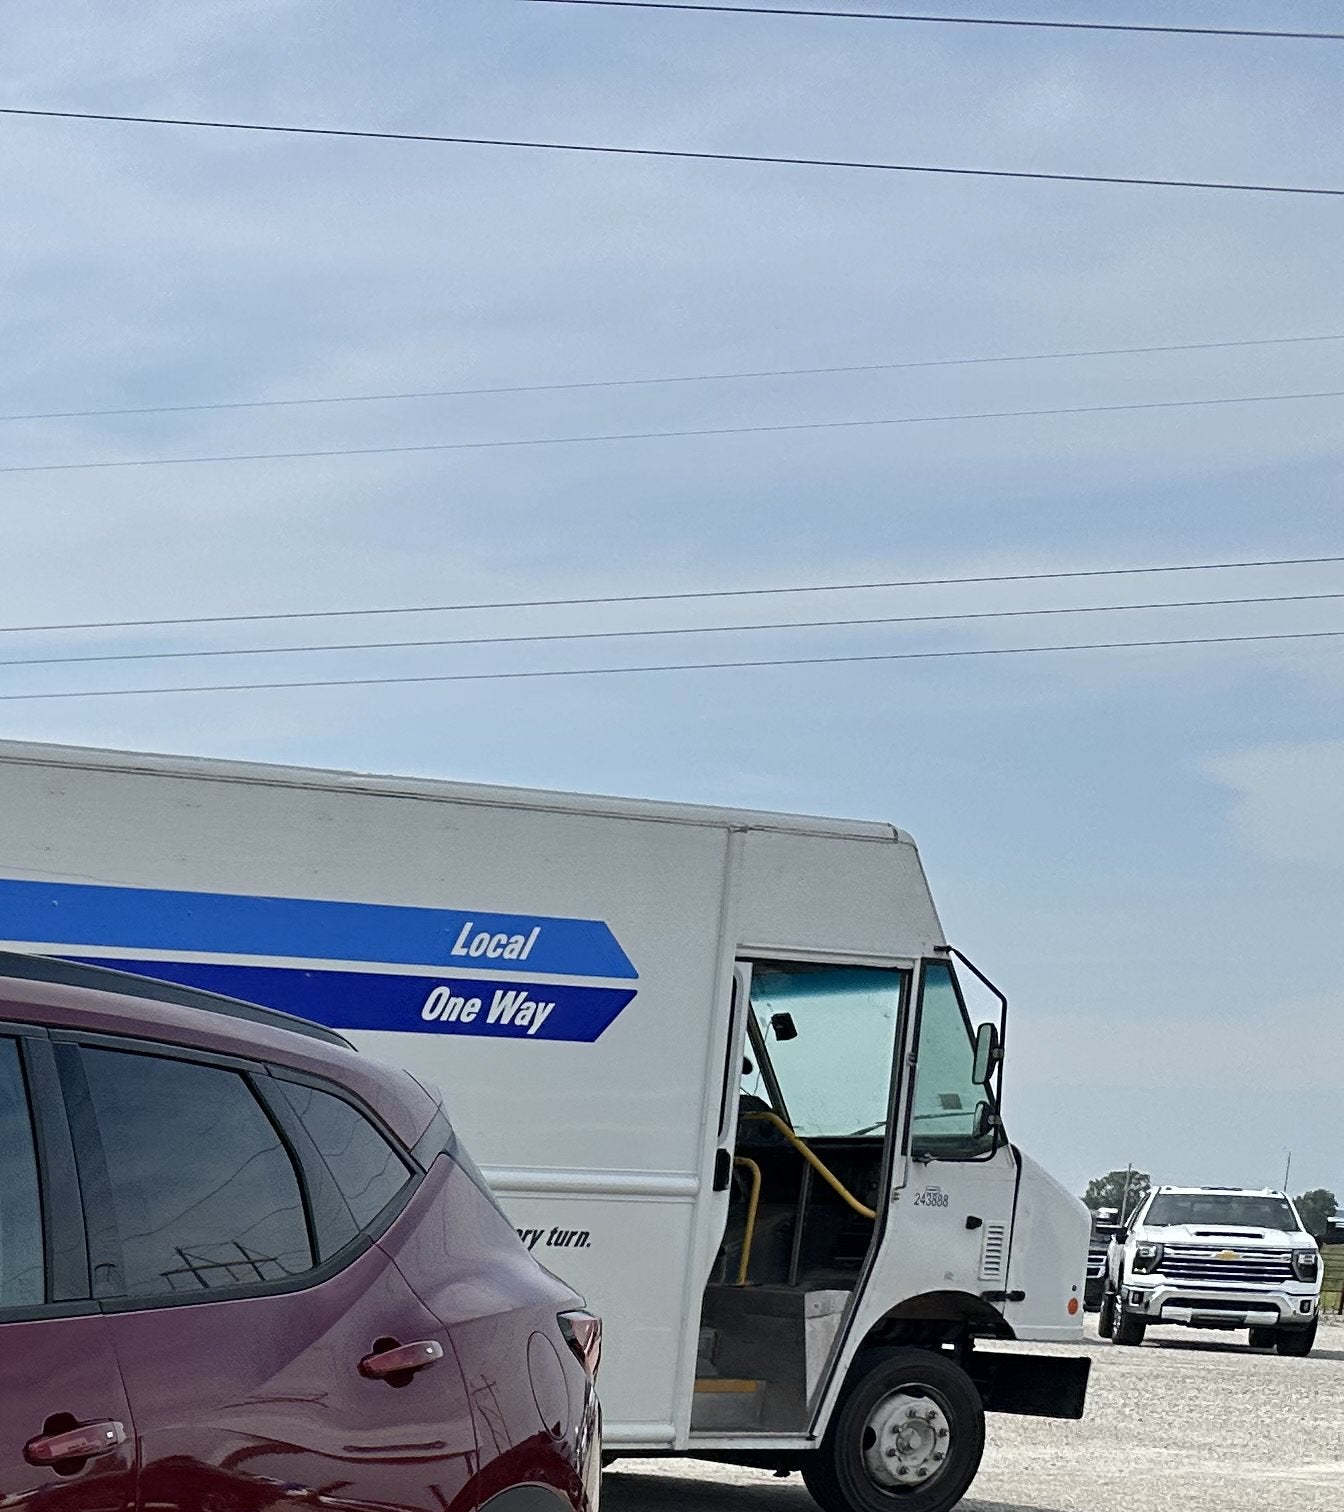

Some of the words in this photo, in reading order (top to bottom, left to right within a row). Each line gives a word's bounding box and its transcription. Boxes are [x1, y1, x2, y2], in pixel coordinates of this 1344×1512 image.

[450, 922, 541, 960] Local
[421, 985, 482, 1023] One
[486, 989, 556, 1035] Way
[546, 1226, 591, 1248] turn.
